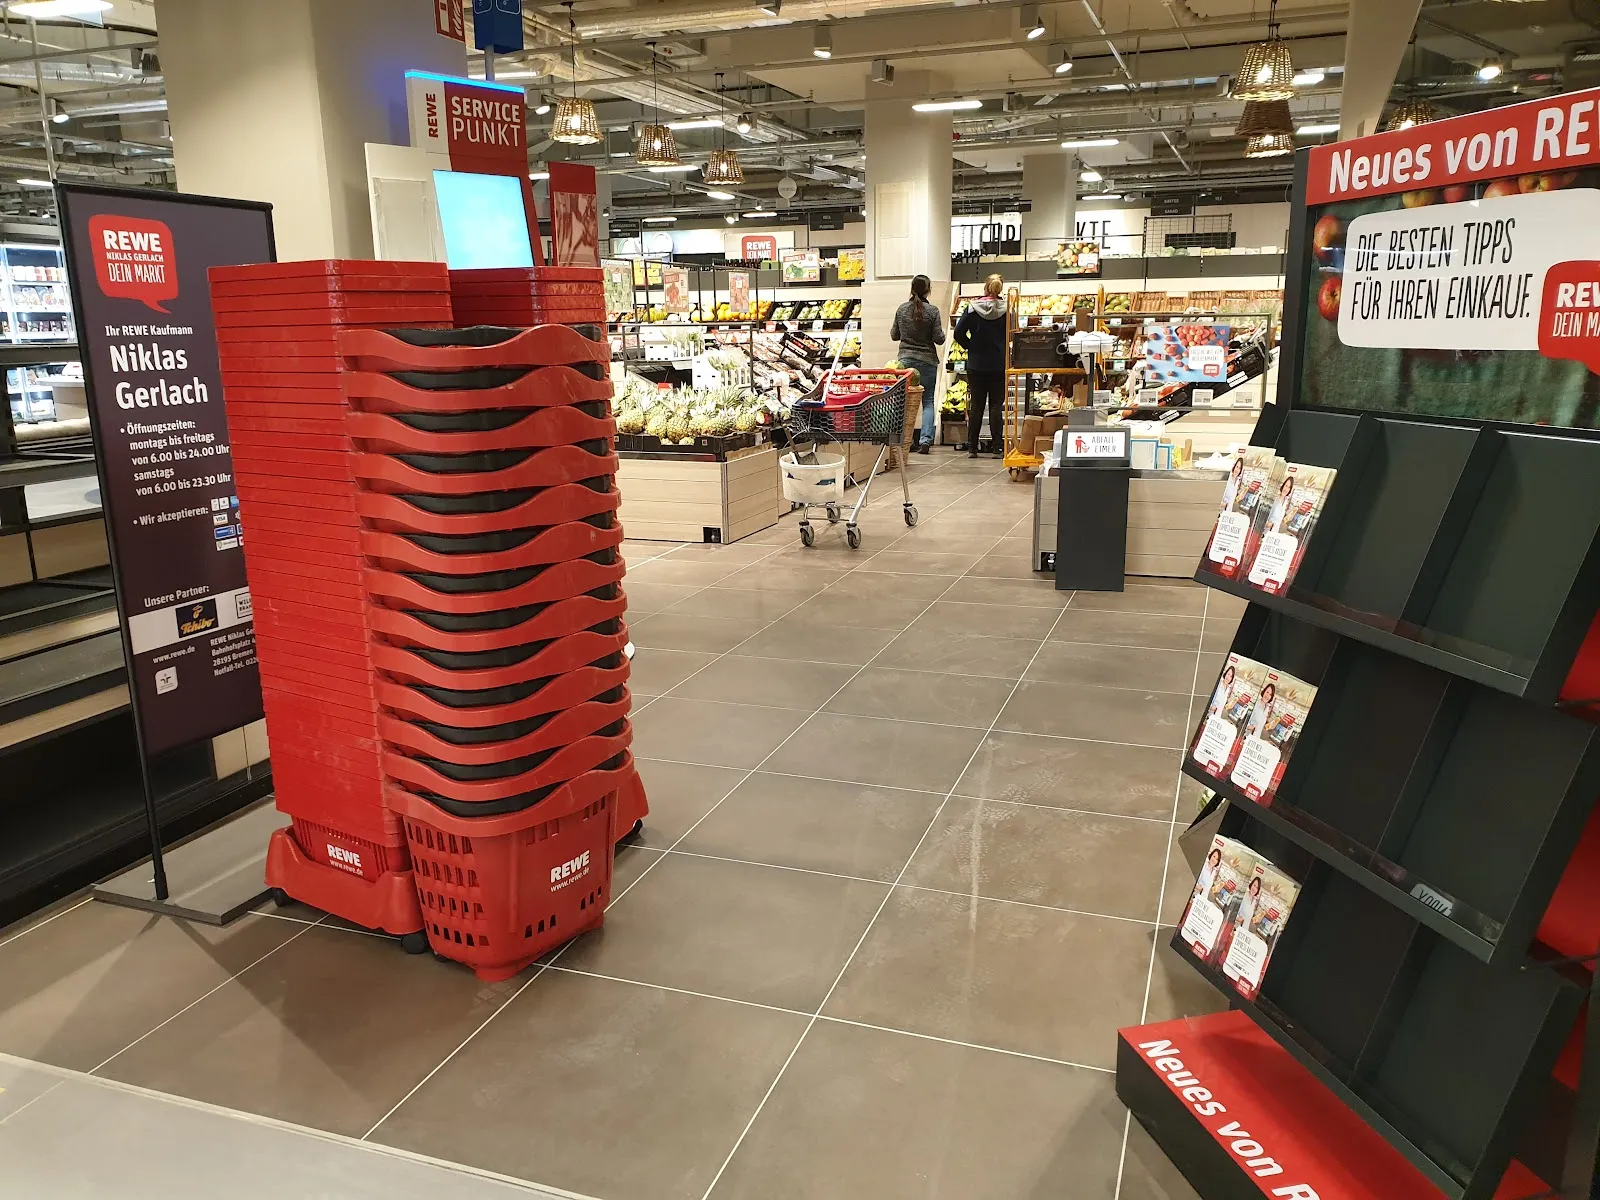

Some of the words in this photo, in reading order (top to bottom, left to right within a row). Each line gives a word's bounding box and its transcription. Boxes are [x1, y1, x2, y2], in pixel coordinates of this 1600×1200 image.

[425, 93, 439, 138] REWE
[451, 96, 520, 122] SERVICE
[452, 118, 520, 147] PUNKT
[1328, 143, 1432, 194] Neues
[1445, 127, 1518, 175] von
[1533, 99, 1600, 161] RE
[103, 229, 163, 252] REWE
[746, 241, 772, 250] REWE
[1355, 232, 1382, 272] DIE
[1387, 225, 1455, 271] BESTEN
[1463, 217, 1516, 267] TIPPS
[106, 252, 132, 261] NIKLAS
[133, 253, 164, 262] GERLACH
[107, 262, 132, 283] DEIN
[134, 264, 165, 283] MARKT
[1351, 276, 1382, 320] FÜR
[1387, 278, 1440, 320] IHREN
[1445, 272, 1534, 319] EINKAUF.
[104, 325, 120, 336] Ihr
[122, 325, 149, 336] REWE
[150, 324, 193, 336] Kaufmann
[1552, 312, 1583, 337] DEIN
[109, 343, 188, 372] Niklas
[115, 377, 209, 410] Gerlach
[127, 420, 196, 435] Öffnungszeiten:
[130, 438, 167, 451] montags
[169, 435, 182, 446] bis
[183, 432, 215, 445] freitags
[1094, 445, 1116, 453] EIMER
[131, 456, 149, 466] von
[150, 452, 172, 463] 6.00
[174, 449, 187, 460] bis
[188, 446, 214, 459] 24.00
[215, 444, 230, 455] Uhr
[134, 467, 175, 481] samstags
[136, 486, 153, 496] von
[154, 482, 177, 494] 6.00
[178, 479, 191, 490] bis
[192, 475, 216, 488] 23.30
[217, 473, 231, 483] Uhr
[139, 513, 155, 526] Wir
[157, 506, 209, 523] akzeptieren:
[144, 594, 175, 608] Unsere
[176, 585, 210, 600] Partner:
[180, 617, 215, 635] Tchibo
[210, 635, 227, 646] REWE
[227, 631, 245, 641] Niklas
[211, 639, 251, 656] Bahnhofsplatz
[152, 646, 195, 664] www.rewe.de
[212, 654, 232, 667] 28195
[232, 649, 254, 660] Bremen
[326, 843, 362, 867] REWE
[550, 849, 590, 883] REWE
[550, 866, 590, 892] www.rewe.de
[1138, 1039, 1227, 1116] Neues
[1217, 1121, 1284, 1177] von
